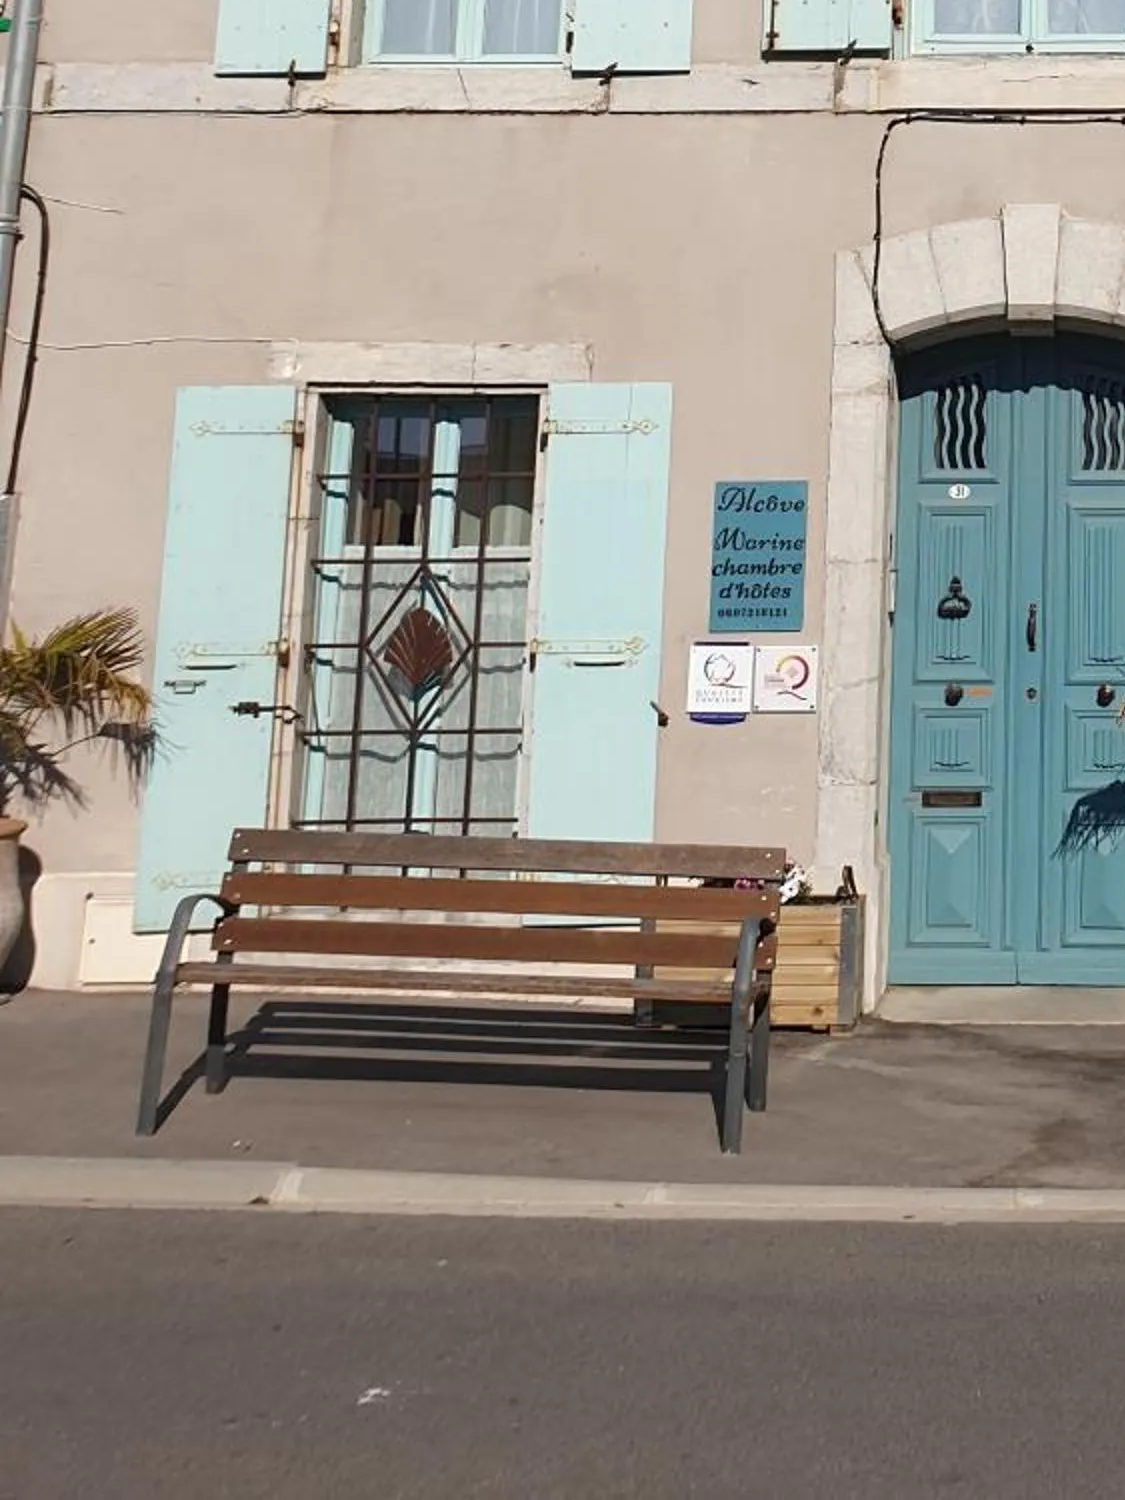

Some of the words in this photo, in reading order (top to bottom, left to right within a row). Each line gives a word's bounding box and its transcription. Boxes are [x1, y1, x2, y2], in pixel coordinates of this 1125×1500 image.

[717, 486, 806, 512] Alcôve
[713, 527, 806, 551] Marine
[711, 557, 803, 576] chambre
[719, 582, 792, 599] d'hôtes
